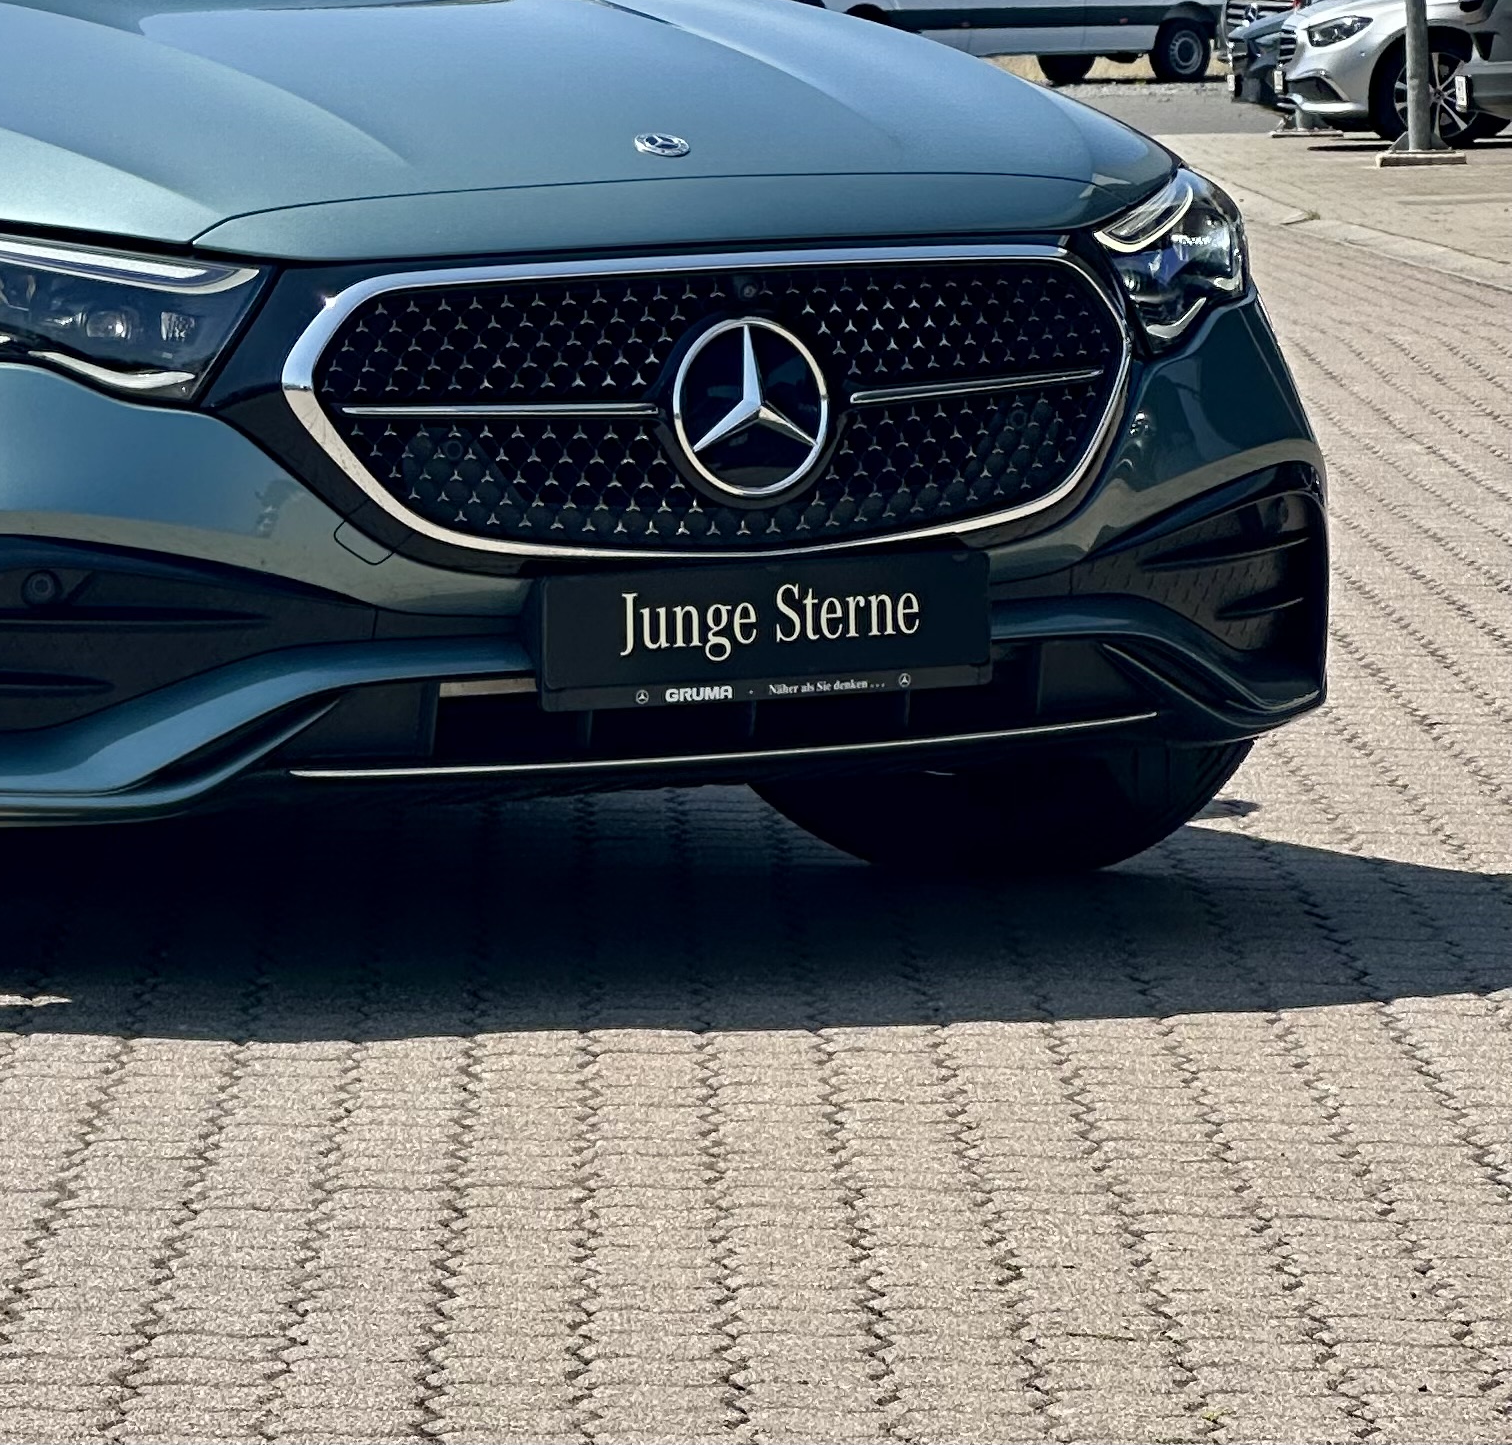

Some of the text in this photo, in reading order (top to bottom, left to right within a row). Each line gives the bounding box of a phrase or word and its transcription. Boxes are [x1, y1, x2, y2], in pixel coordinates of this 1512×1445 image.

[620, 583, 920, 662] Junge Sterne
[665, 685, 733, 703] GRUMA
[768, 683, 799, 696] Näher
[801, 681, 815, 693] als
[816, 680, 831, 692] Sie
